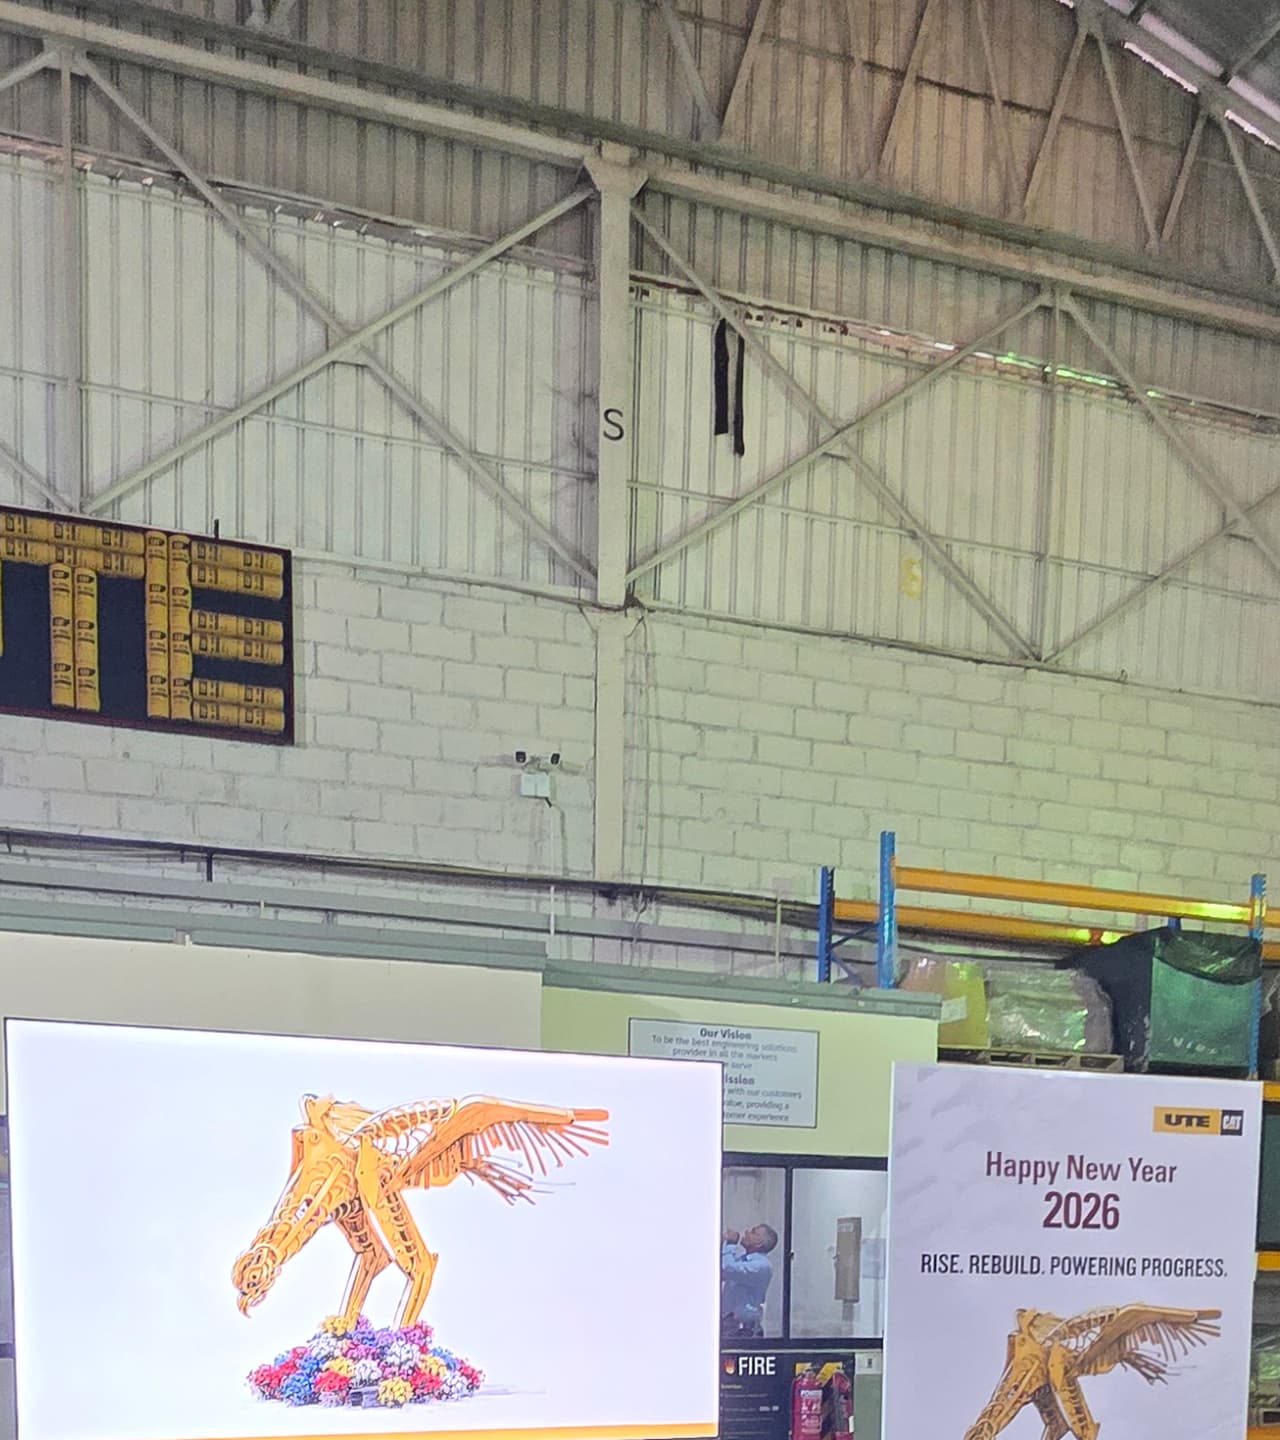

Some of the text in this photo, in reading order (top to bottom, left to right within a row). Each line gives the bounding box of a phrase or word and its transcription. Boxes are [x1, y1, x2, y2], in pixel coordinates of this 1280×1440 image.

[603, 407, 625, 441] S
[664, 1035, 674, 1045] be
[675, 1036, 690, 1045] the
[692, 1037, 710, 1047] best
[700, 1028, 752, 1041] Our Vision
[672, 1047, 707, 1058] provider
[725, 1073, 755, 1086] ission
[1164, 1113, 1243, 1130] UTE CAT
[986, 1151, 1178, 1186] Happy New Year
[1042, 1191, 1120, 1230] 2026
[920, 1253, 1228, 1279] RISE. REBUILD. POWERING PROGRESS.
[738, 1356, 777, 1376] FIRE
